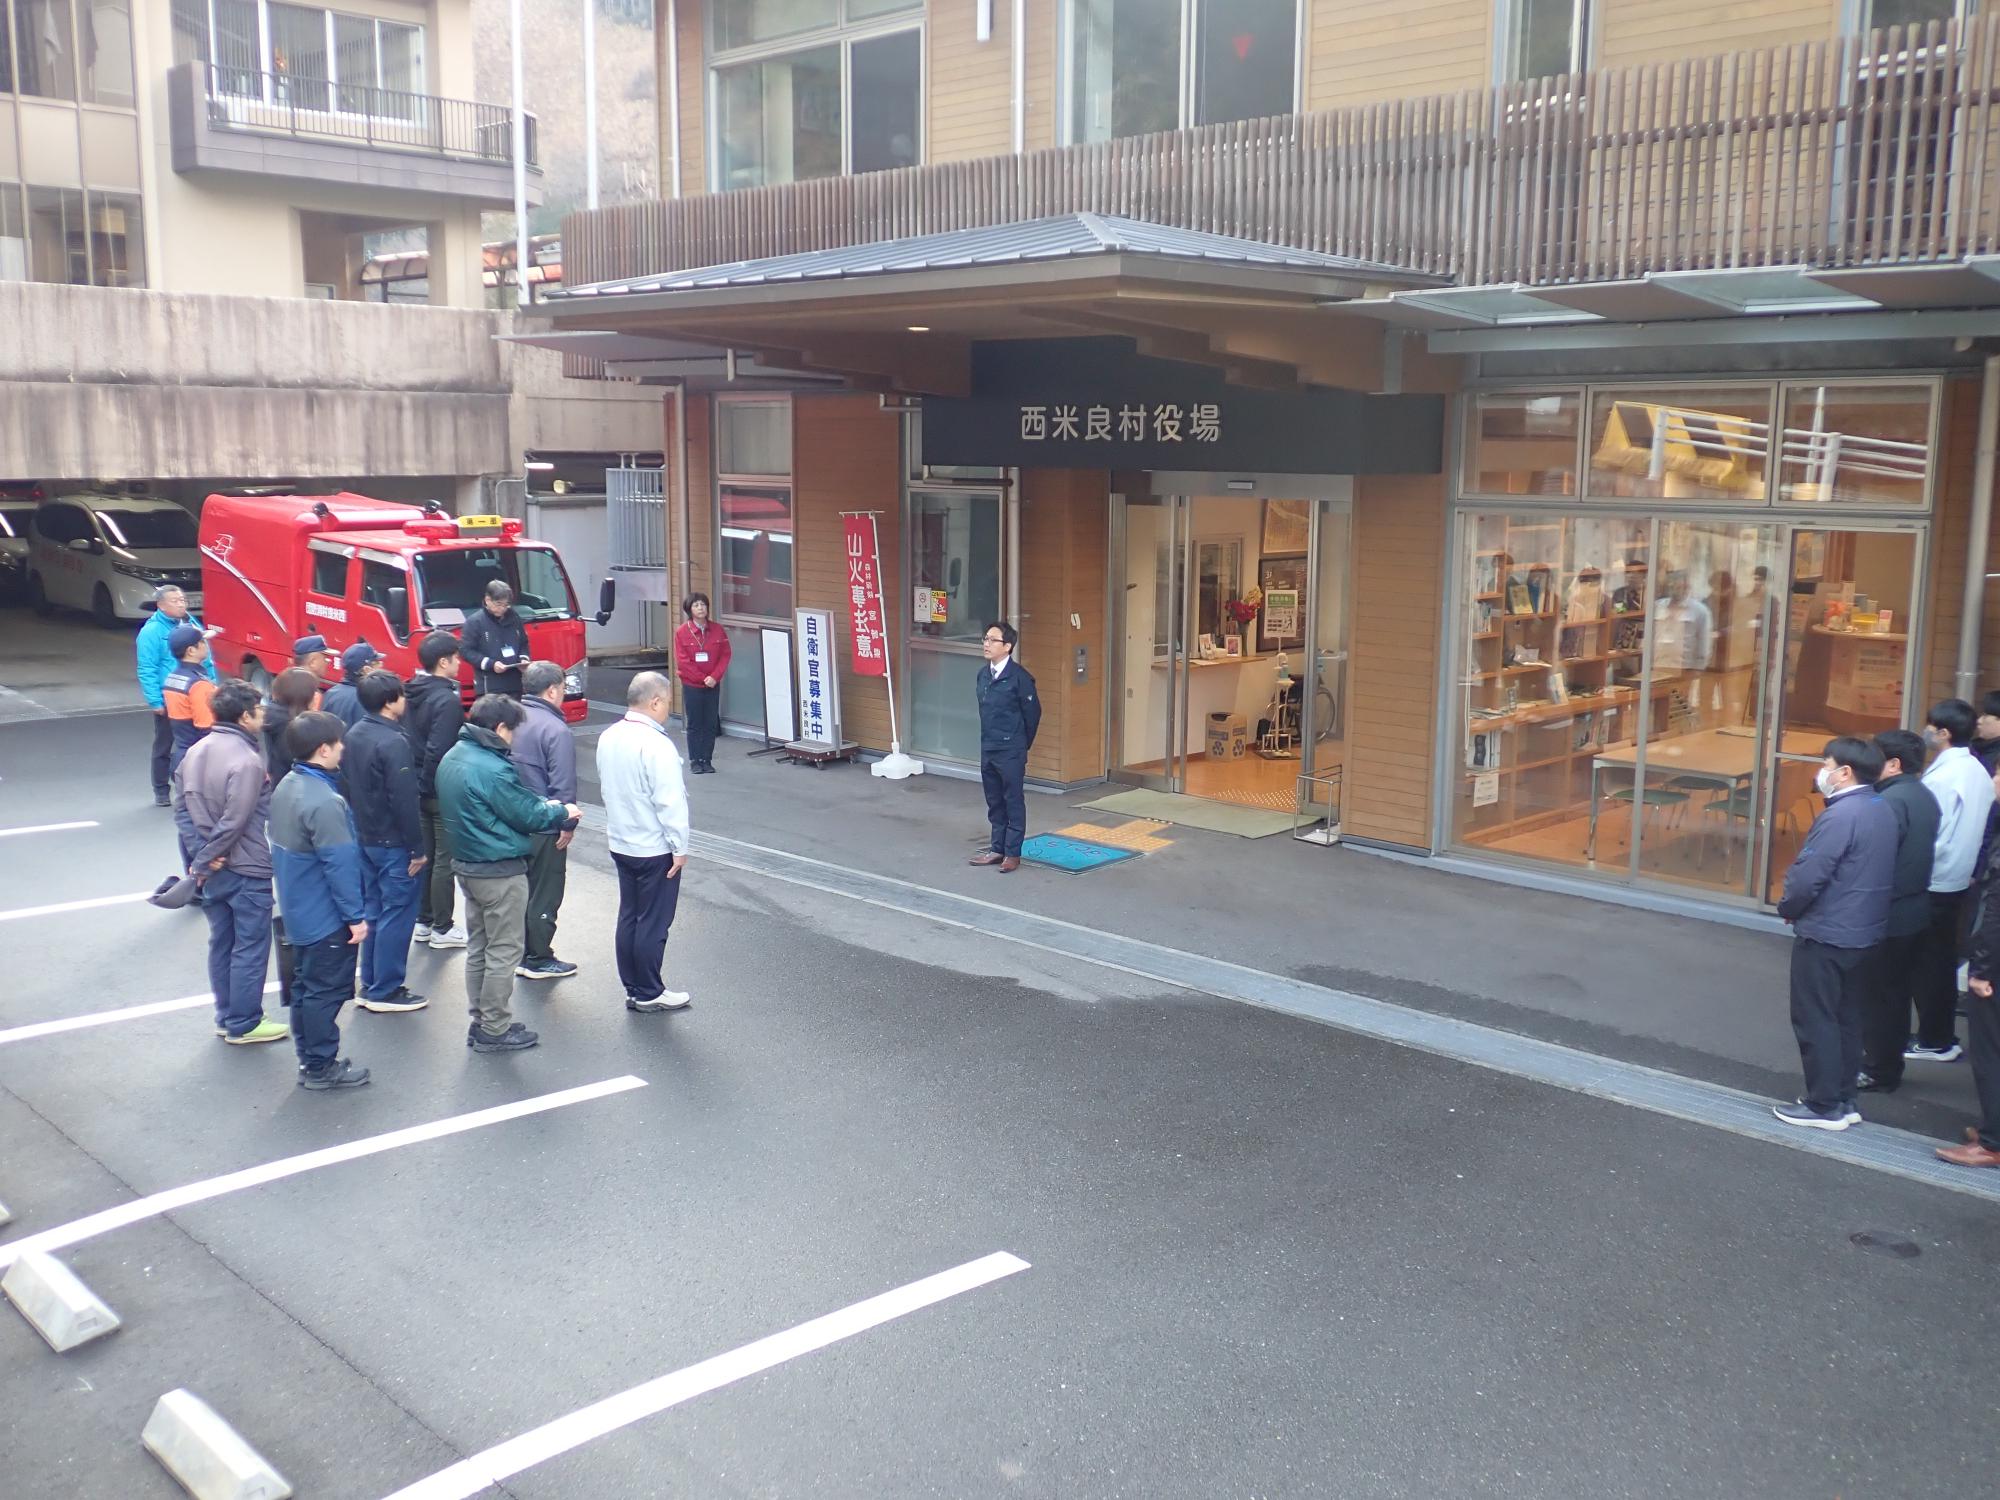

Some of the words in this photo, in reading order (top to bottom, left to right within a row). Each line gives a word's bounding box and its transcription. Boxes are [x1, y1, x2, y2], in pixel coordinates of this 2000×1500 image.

[1020, 402, 1221, 442] 西米良村役場
[847, 532, 874, 659] 山火事注意
[802, 699, 811, 738] 西米良村
[806, 616, 823, 740] 自衛官募集中
